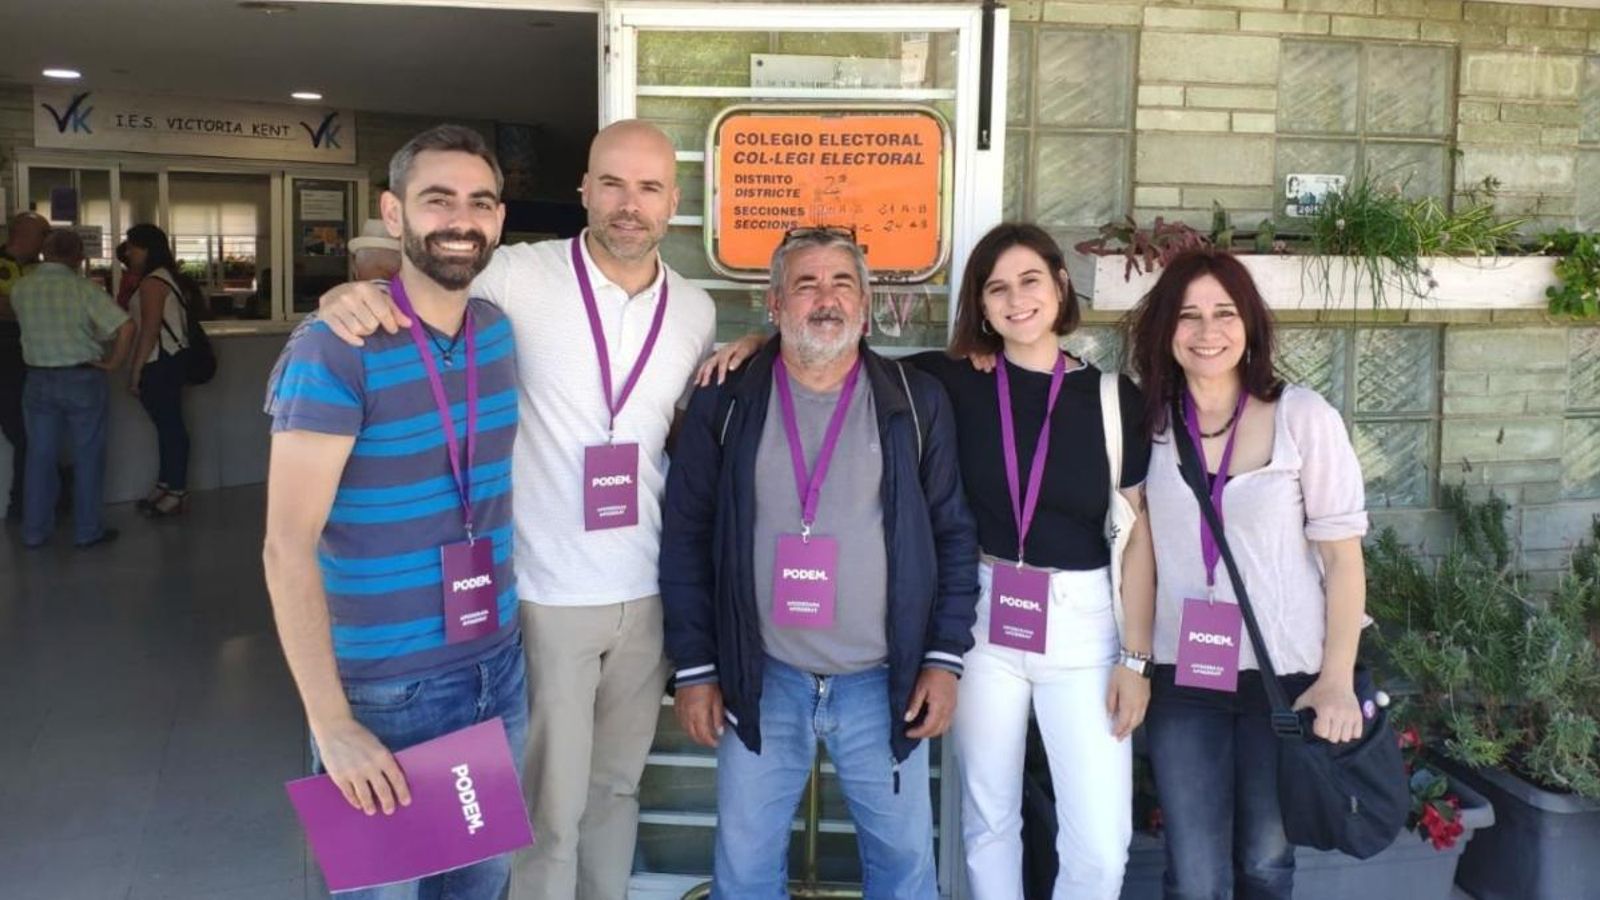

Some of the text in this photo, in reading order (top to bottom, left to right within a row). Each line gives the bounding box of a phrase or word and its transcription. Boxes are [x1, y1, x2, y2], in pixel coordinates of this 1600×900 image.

[115, 113, 291, 138] I.E.S. VICTORIA KENT
[734, 132, 924, 147] COLEGIO ELECTORAL
[820, 151, 925, 166] ELECTORAL
[734, 174, 793, 185] DISTRITO
[734, 188, 801, 199] DISTRICTE
[734, 206, 806, 217] SECCIONES
[734, 219, 799, 230] SECCIONS
[783, 568, 829, 581] PODEM.
[450, 763, 485, 836] PODEM.
